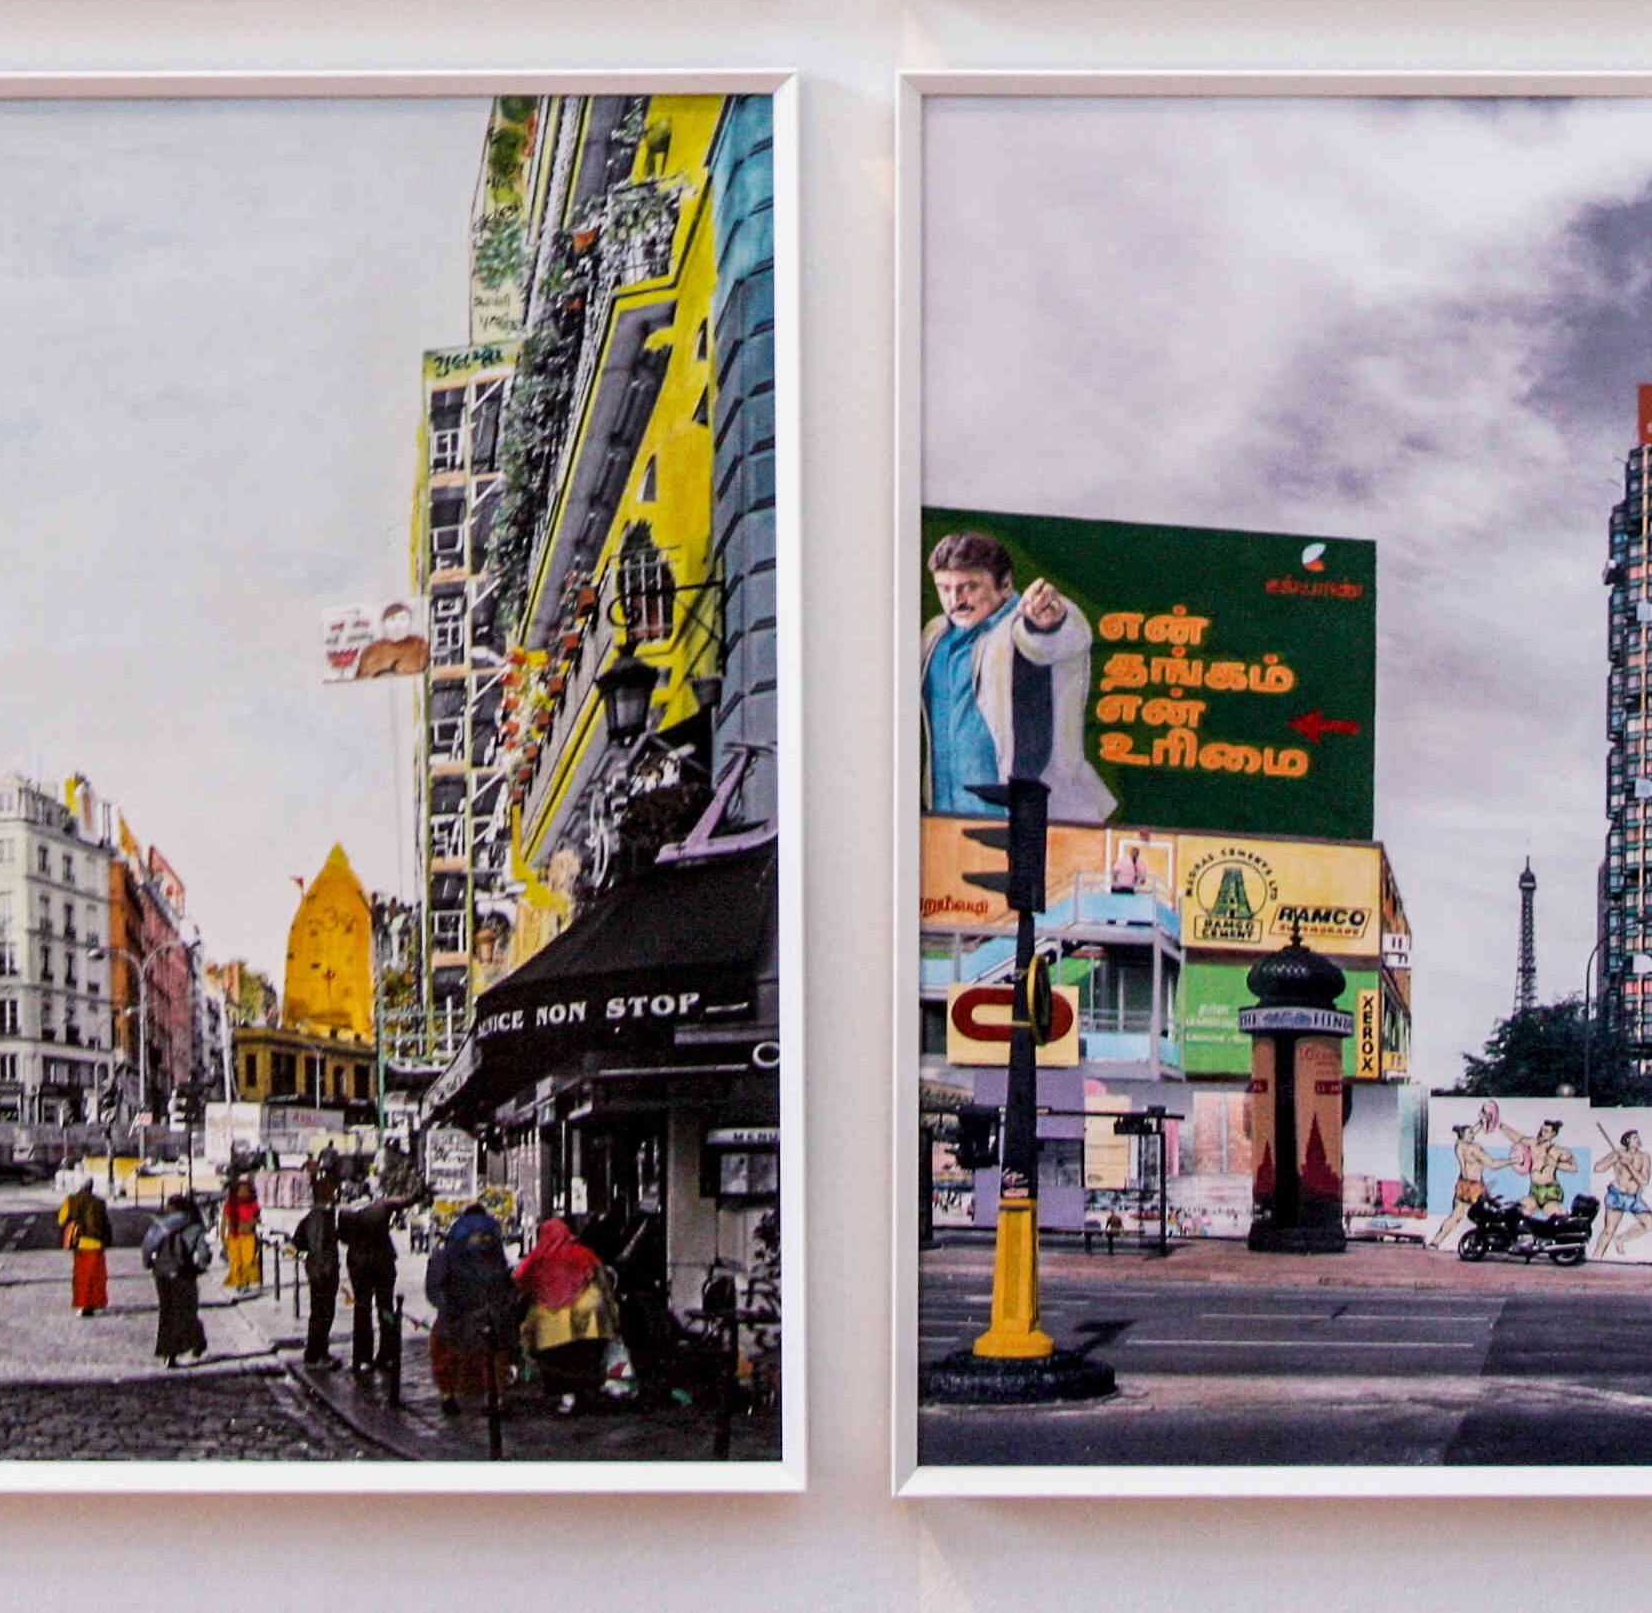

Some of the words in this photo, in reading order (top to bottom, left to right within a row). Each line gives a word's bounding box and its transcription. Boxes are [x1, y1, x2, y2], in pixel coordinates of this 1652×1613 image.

[1098, 603, 1211, 646] என்
[1100, 646, 1295, 694] தங்கம்
[1096, 687, 1207, 728] என்
[1099, 727, 1309, 779] உரிமை
[1278, 906, 1366, 927] RAMCO
[536, 1000, 587, 1027] NON
[604, 992, 702, 1020] STOP
[1360, 994, 1375, 1072] XEROX
